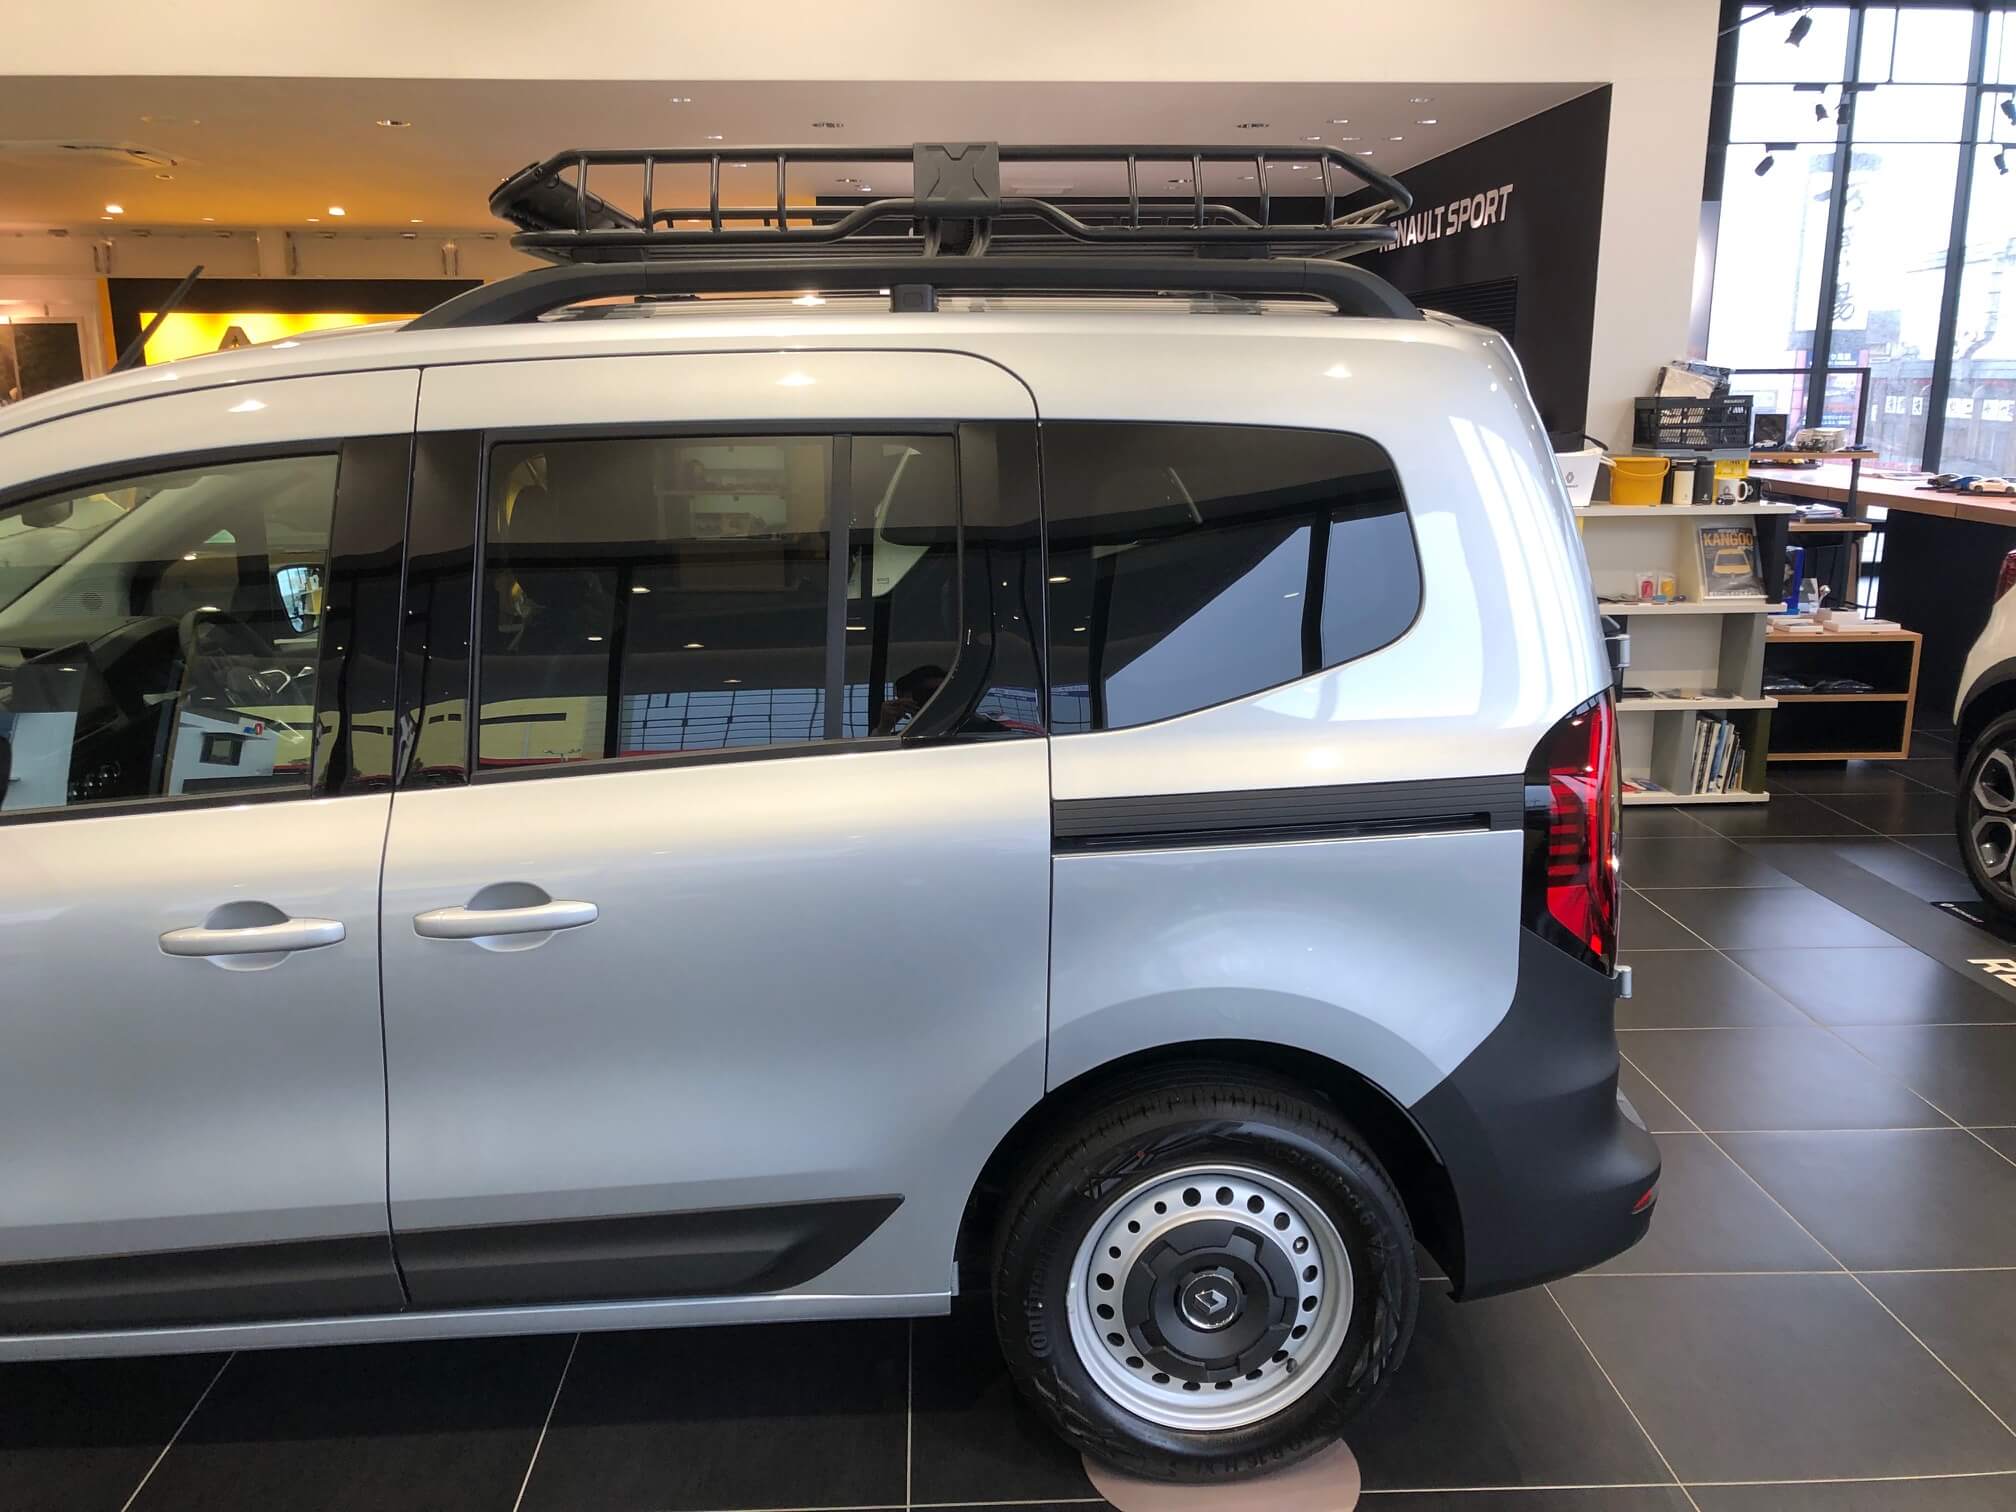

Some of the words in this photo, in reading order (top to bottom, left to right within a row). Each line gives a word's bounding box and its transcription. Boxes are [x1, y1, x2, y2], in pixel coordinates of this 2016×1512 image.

[1379, 206, 1445, 253] NAULT
[1445, 184, 1514, 236] SPORT
[1703, 531, 1754, 546] KANGOO
